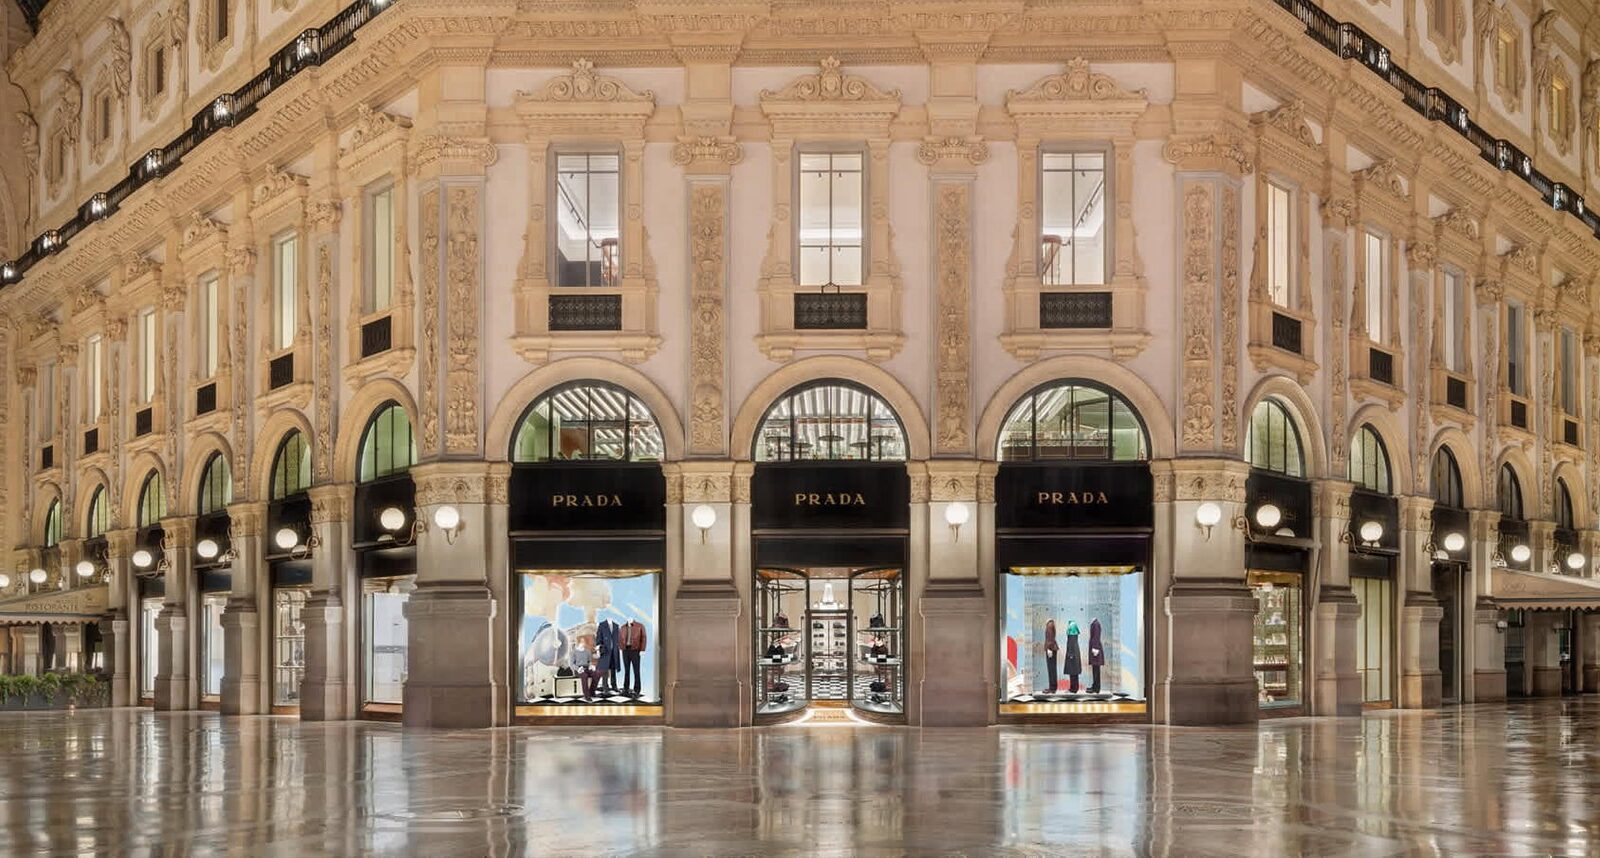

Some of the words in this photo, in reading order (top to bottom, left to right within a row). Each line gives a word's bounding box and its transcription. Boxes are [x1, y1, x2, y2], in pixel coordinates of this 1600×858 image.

[553, 495, 622, 506] PRADA
[795, 493, 865, 505] PRADA
[1038, 492, 1108, 504] PRADA
[25, 603, 78, 611] RISTORANTE
